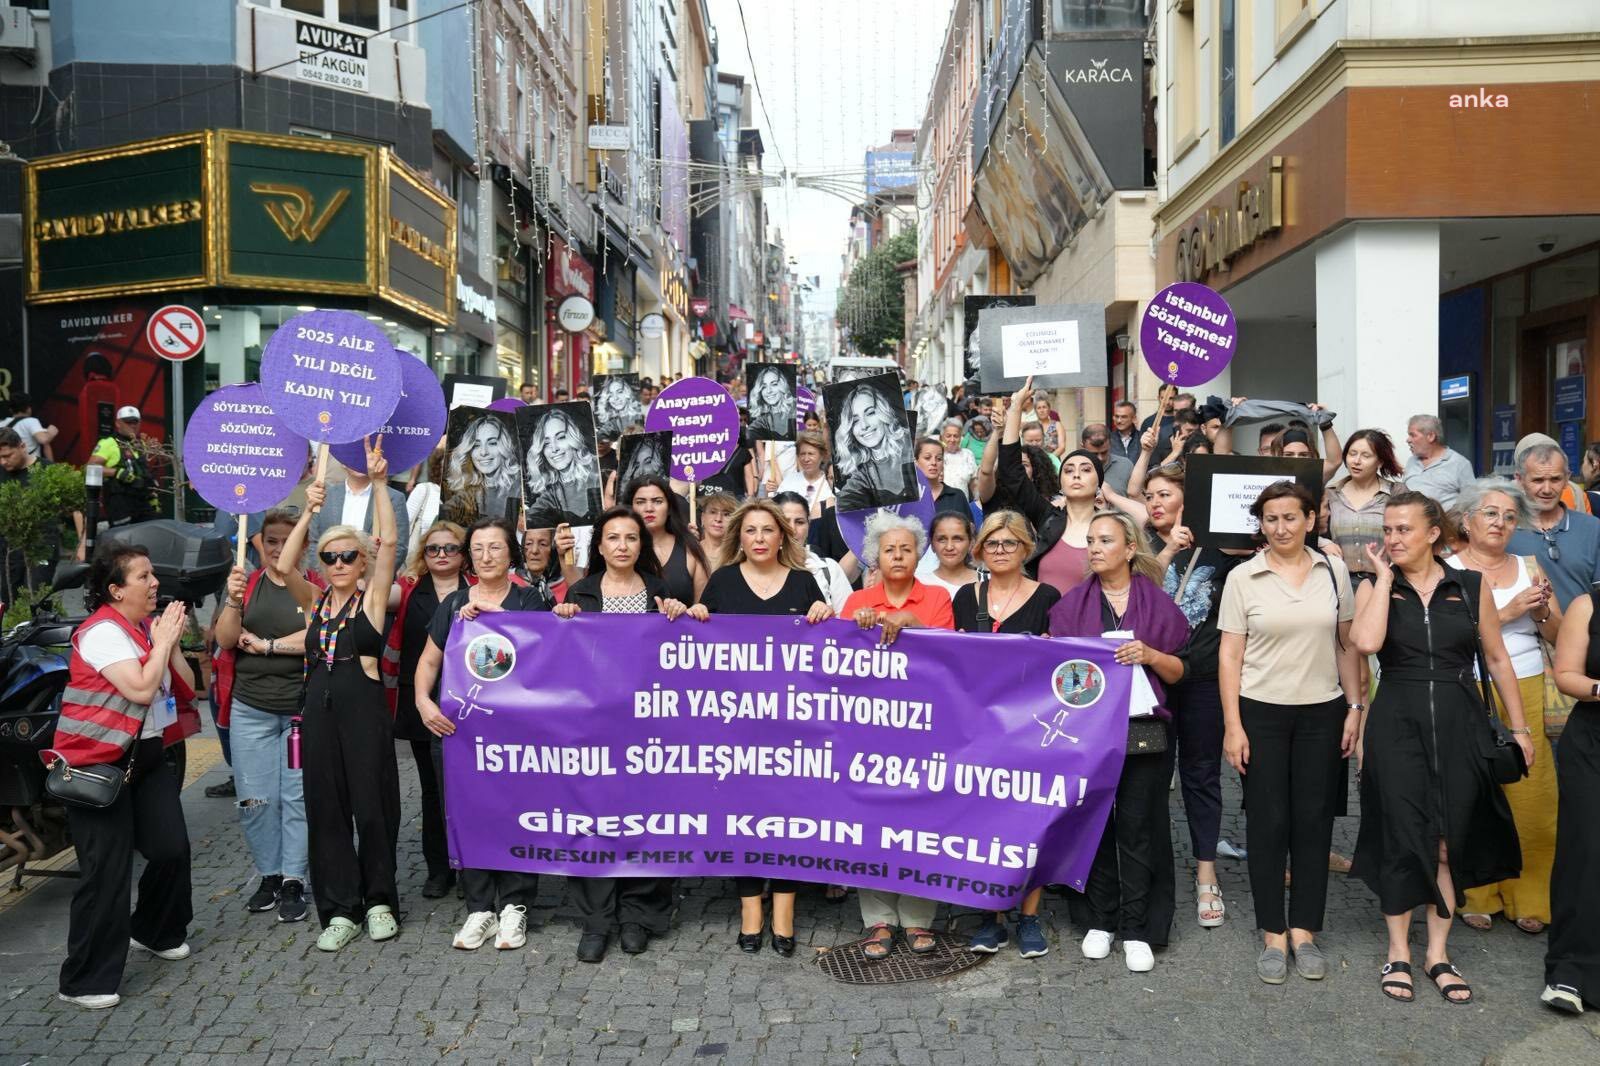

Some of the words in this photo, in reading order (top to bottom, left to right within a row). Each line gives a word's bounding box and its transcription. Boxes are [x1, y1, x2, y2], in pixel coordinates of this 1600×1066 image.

[299, 25, 365, 55] AVUKAT
[321, 56, 366, 77] AKGÜN
[1065, 68, 1133, 83] KARACA
[1148, 304, 1233, 349] Sözleşmesi
[297, 327, 335, 345] 2025
[337, 334, 376, 353] AİLE
[1157, 327, 1210, 361] Yaşatır.
[292, 354, 326, 372] YILI
[329, 361, 377, 381] DEĞİL
[284, 381, 335, 401] KADIN
[339, 391, 372, 408] YILI
[655, 393, 726, 410] Anayasayı
[220, 422, 276, 437] SÖZÜMÜZ,
[396, 425, 431, 436] YERDE
[668, 414, 713, 428] Yasayı
[207, 442, 284, 457] DEĞİŞTİRECEK
[671, 428, 729, 448] zleşmeyi
[201, 462, 257, 477] GÜCÜMÜZ
[259, 467, 287, 478] VAR!
[671, 450, 727, 467] YGULA!
[659, 635, 773, 672] GÜVENLİ
[781, 643, 814, 672] VE
[821, 638, 909, 681] ÖZGÜR
[634, 683, 680, 718] BİR
[686, 689, 778, 724] YAŞAM
[786, 684, 933, 731] İSTİYORUZ!
[475, 736, 617, 777] İSTANBUL
[625, 737, 840, 783] SÖZLEŞMESİNİ,
[848, 751, 947, 793] 6284'Ü
[954, 763, 1068, 808] UYGULA
[518, 807, 708, 837] GİRESUN
[726, 814, 863, 846] KADIN
[880, 826, 1039, 870] MECLİSİ
[509, 844, 616, 865] GİRESUN
[626, 850, 694, 865] EMEK
[703, 850, 735, 865] VE
[744, 851, 889, 879] DEMOKRASİ
